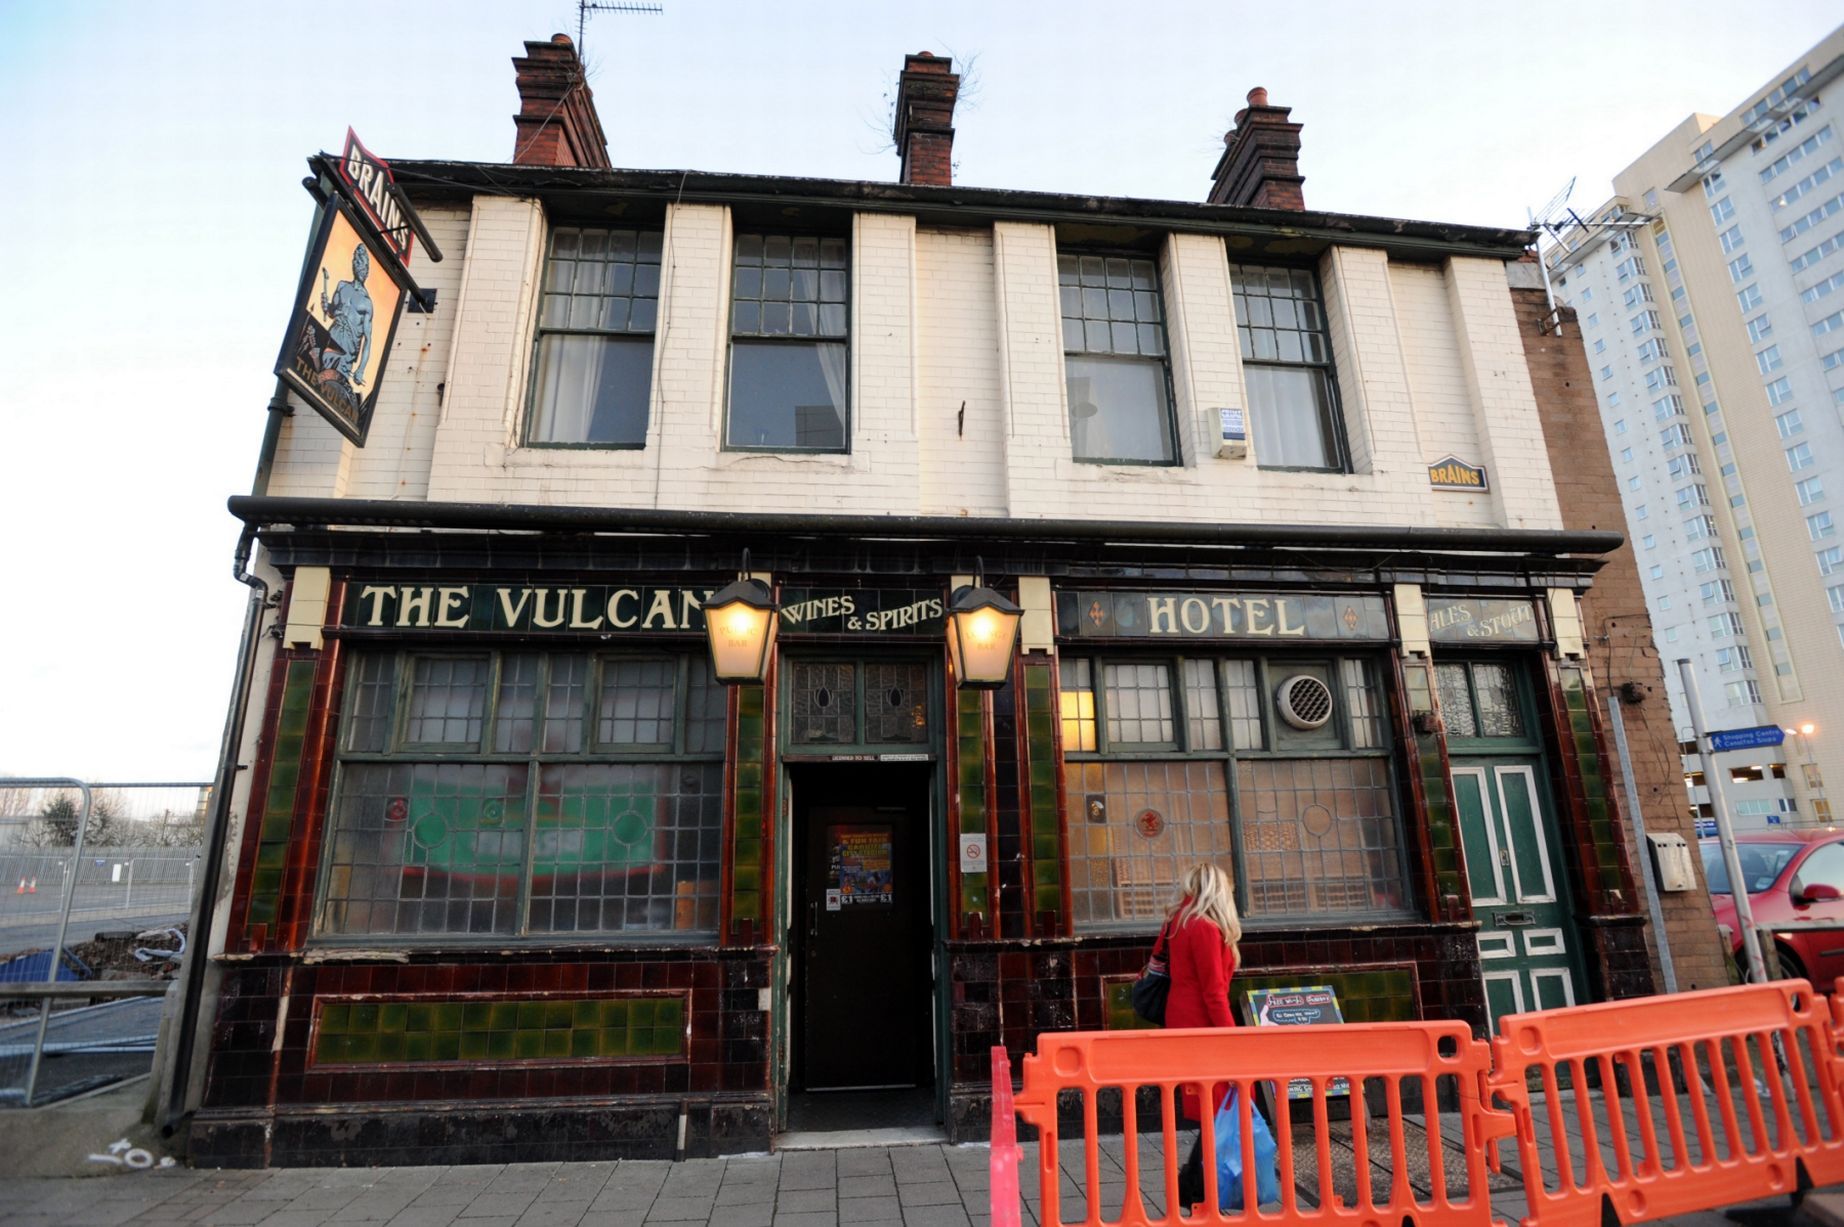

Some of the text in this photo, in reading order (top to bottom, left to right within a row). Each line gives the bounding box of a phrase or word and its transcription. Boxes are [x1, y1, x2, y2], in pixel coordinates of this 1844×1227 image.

[348, 144, 409, 250] BRAINS
[296, 356, 319, 386] THE
[1430, 464, 1480, 485] BRAINS
[361, 585, 715, 630] THE VULCAN
[780, 596, 856, 625] WINES
[847, 597, 943, 631] & SPIRITS
[1147, 596, 1306, 637] HOTEL
[1430, 604, 1472, 633] ALES
[1466, 604, 1534, 637] & STOUT
[1755, 729, 1780, 737] Centre
